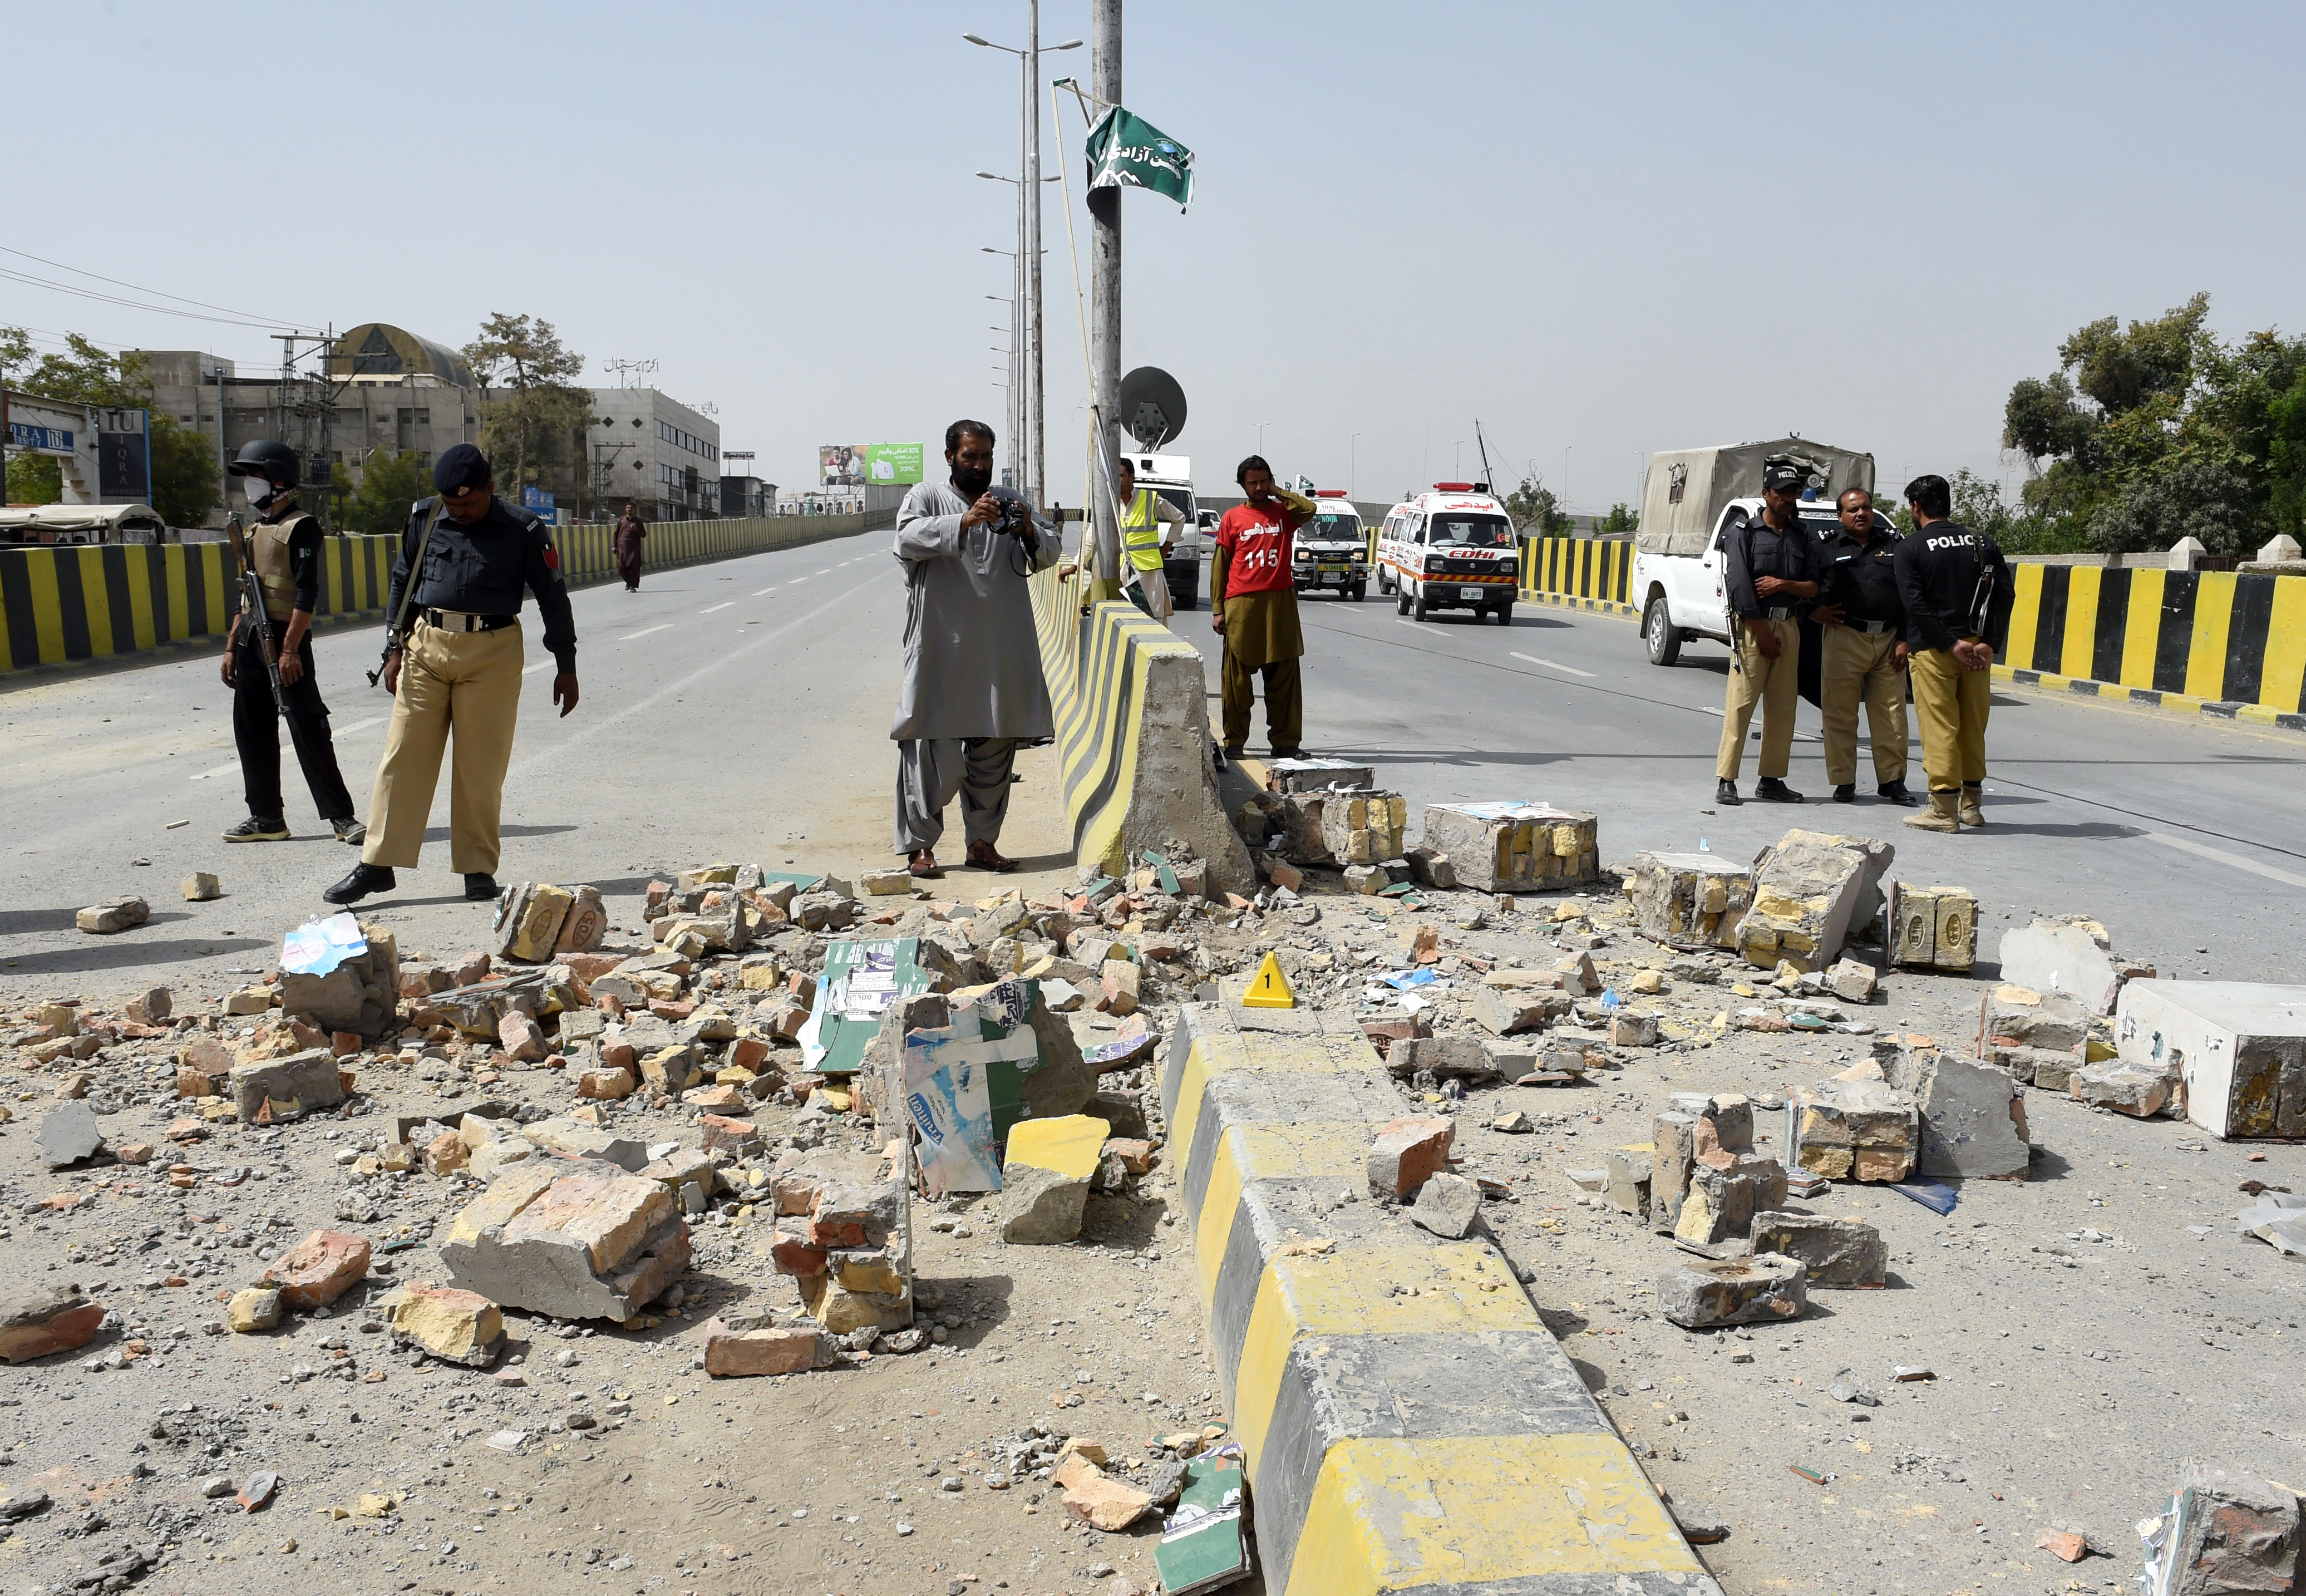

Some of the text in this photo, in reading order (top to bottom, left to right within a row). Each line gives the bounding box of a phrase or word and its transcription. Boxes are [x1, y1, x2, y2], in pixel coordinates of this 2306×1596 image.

[1107, 146, 1154, 162] آزادی
[106, 412, 134, 431] IU
[1926, 534, 1985, 551] POLIC
[1245, 549, 1278, 569] 115
[1449, 550, 1495, 559] EDHI
[1264, 973, 1270, 989] 1
